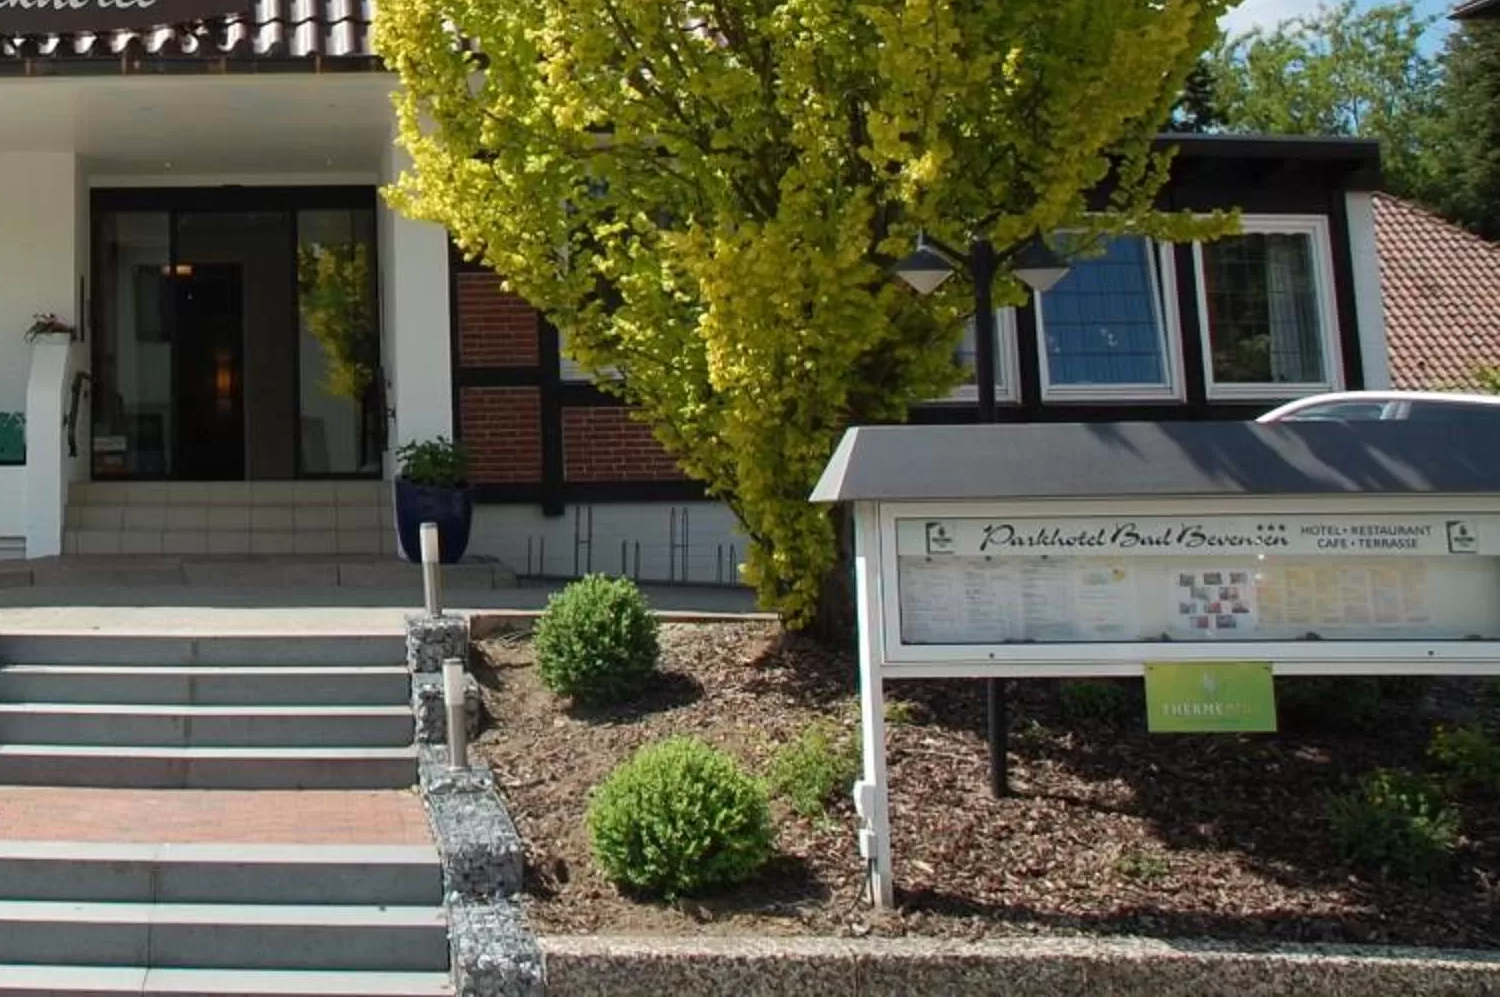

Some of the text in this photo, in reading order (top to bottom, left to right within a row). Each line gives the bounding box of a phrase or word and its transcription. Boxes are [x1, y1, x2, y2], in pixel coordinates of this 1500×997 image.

[1301, 524, 1432, 536] HOTEL RESTAURANT
[980, 523, 1105, 551] Parkhotel
[1111, 522, 1172, 548] Bad
[1359, 537, 1418, 549] TERRASSE
